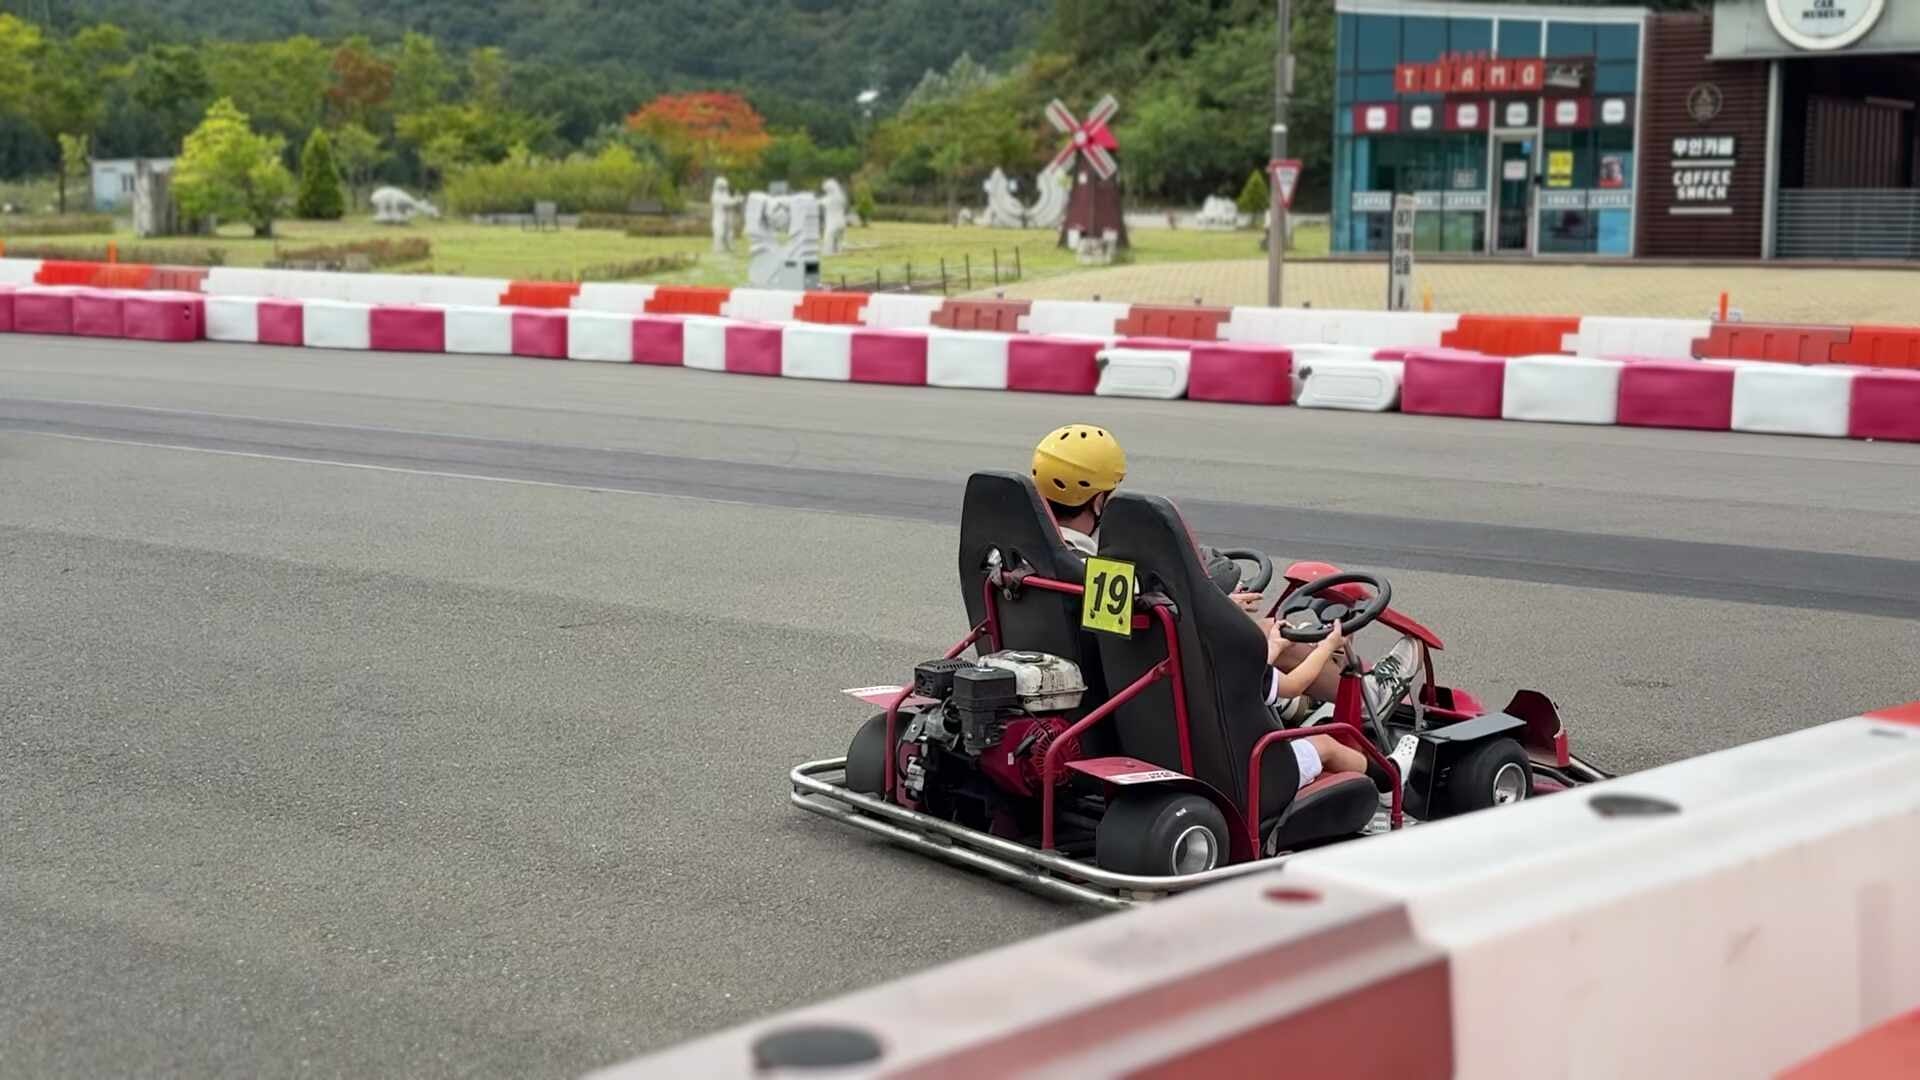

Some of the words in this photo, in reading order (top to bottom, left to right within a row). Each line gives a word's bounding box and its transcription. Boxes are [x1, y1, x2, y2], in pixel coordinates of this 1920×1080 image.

[1802, 9, 1845, 19] MUSEUM
[1404, 65, 1536, 89] TIAMO
[1672, 137, 1733, 157] 무인카페
[1673, 170, 1731, 186] COFFEE
[1677, 185, 1727, 200] SNACK
[1093, 572, 1128, 615] 19
